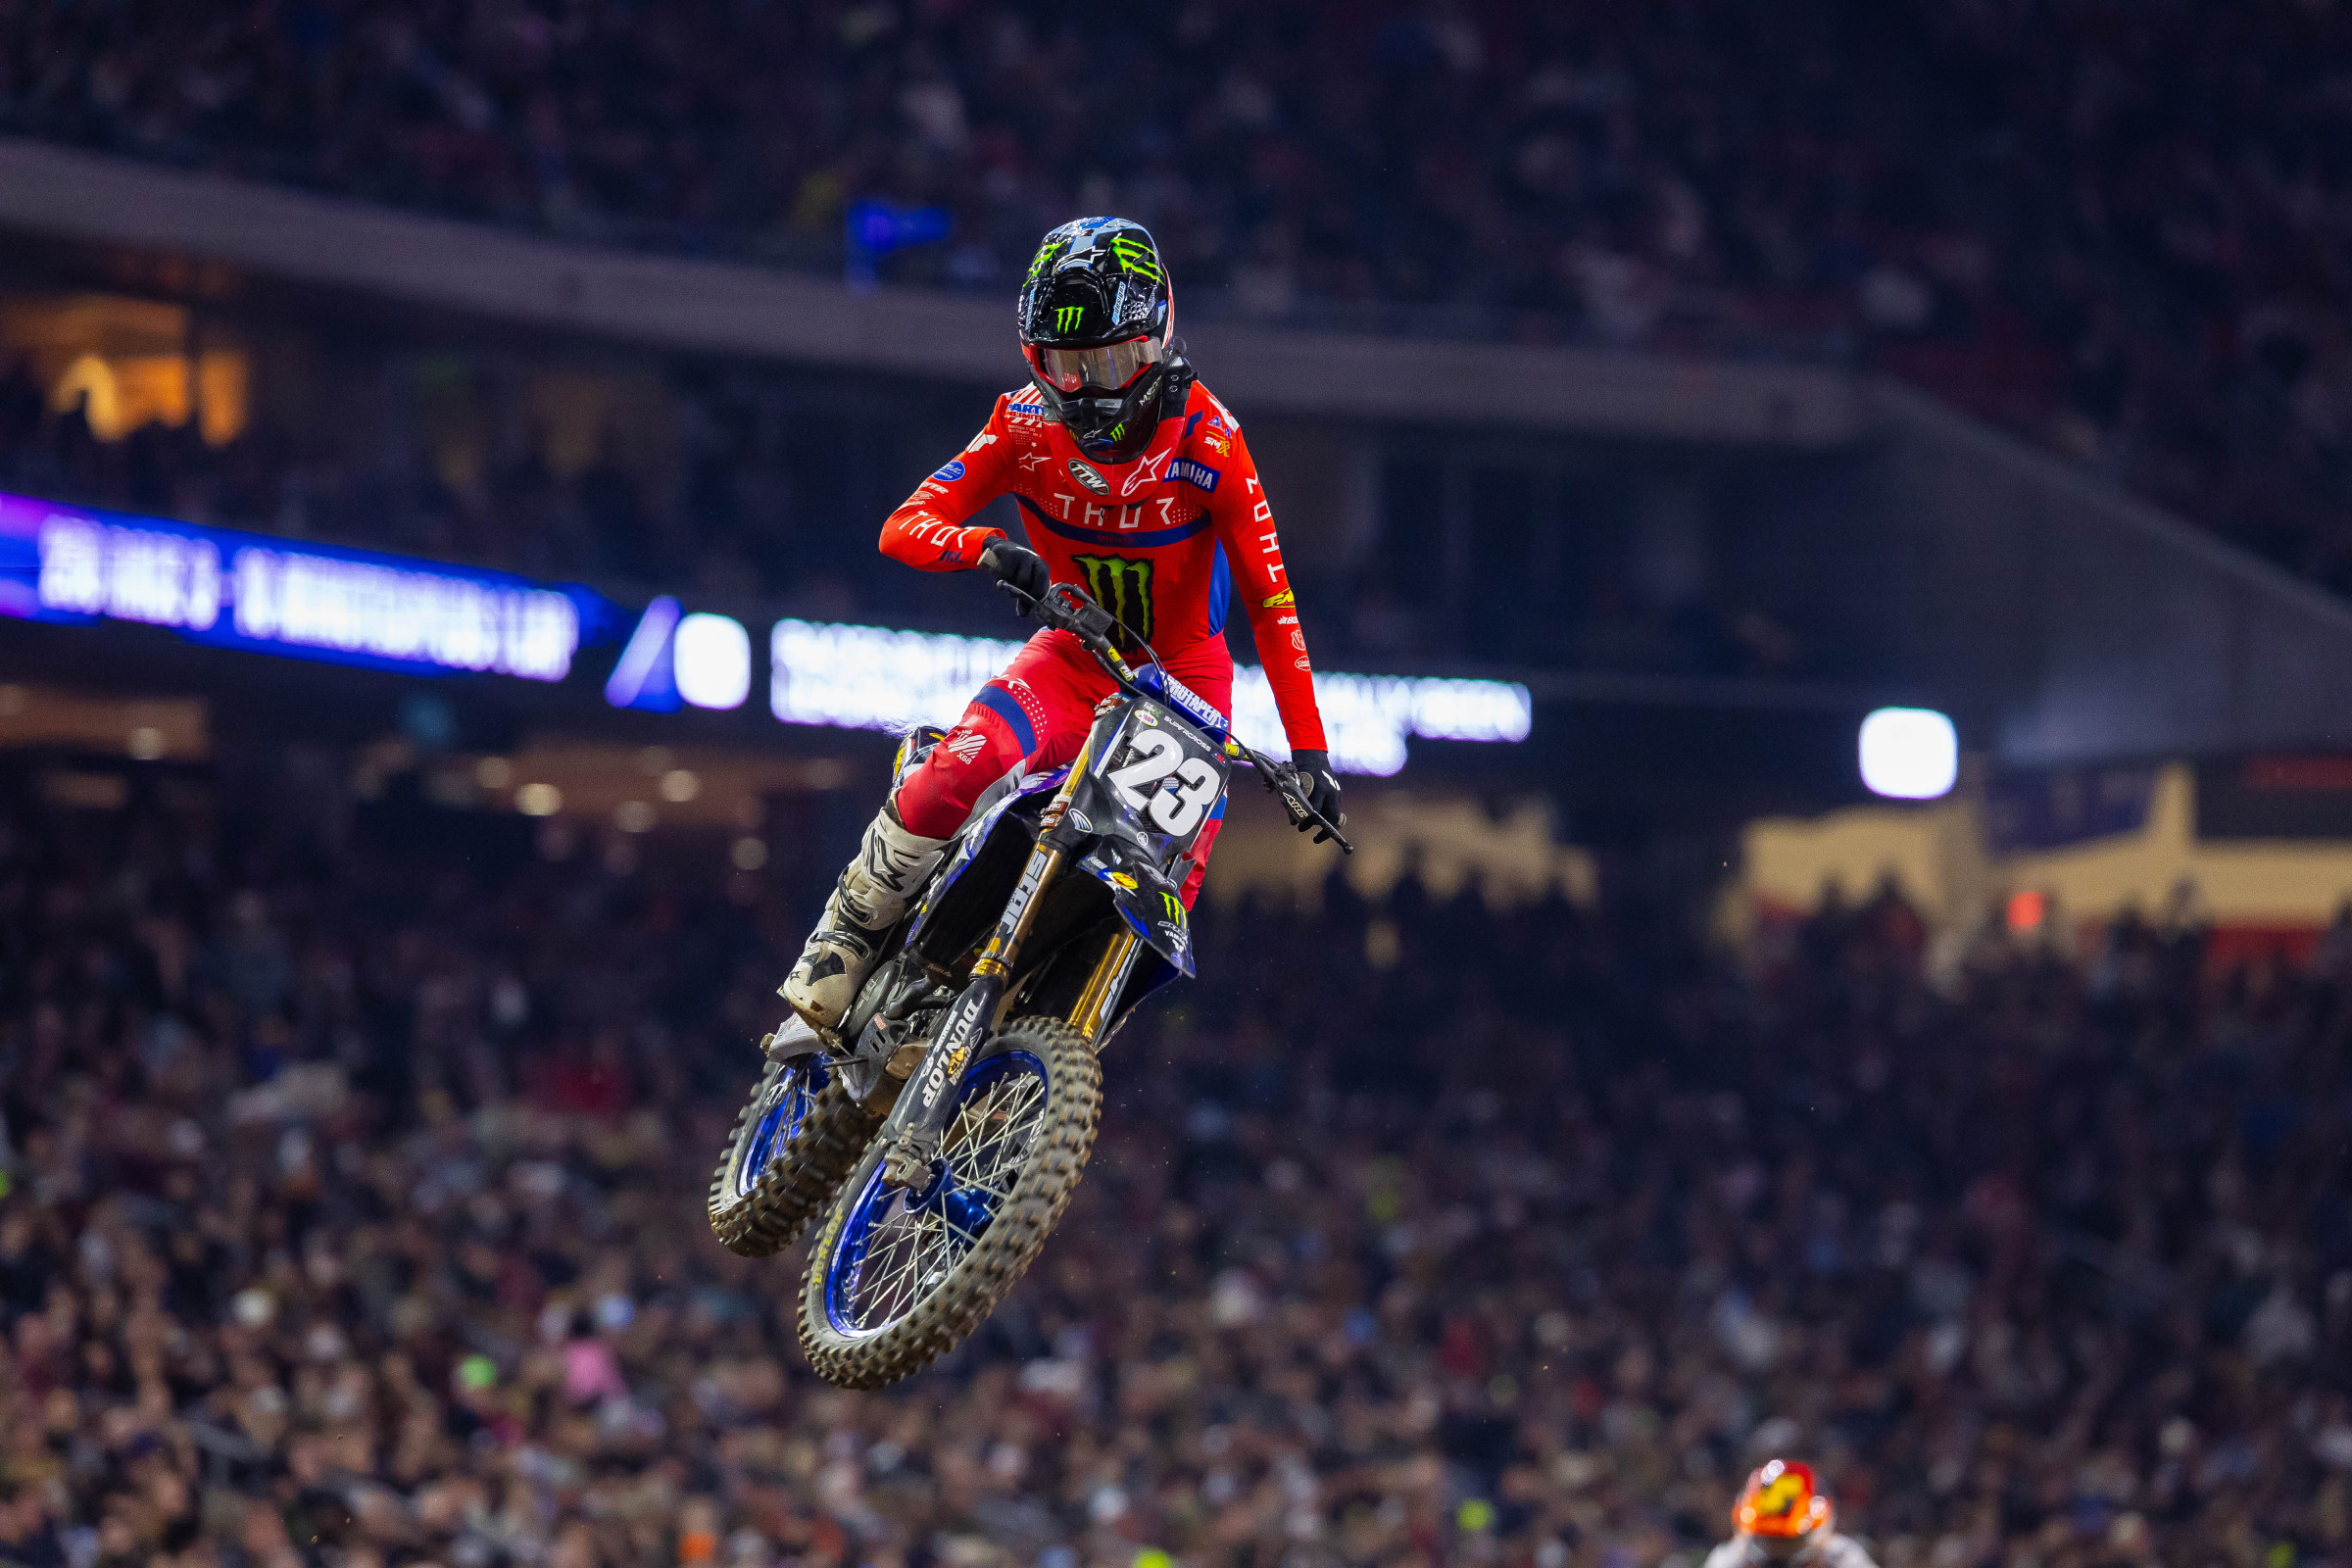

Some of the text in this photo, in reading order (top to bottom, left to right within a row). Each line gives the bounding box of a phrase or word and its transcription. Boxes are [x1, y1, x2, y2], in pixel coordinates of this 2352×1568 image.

[1070, 464, 1108, 490] TTW
[1163, 714, 1212, 752] SUPERCROSS
[1107, 728, 1221, 836] 23
[1283, 793, 1309, 819] ARC
[922, 999, 981, 1108] DUNLOP
